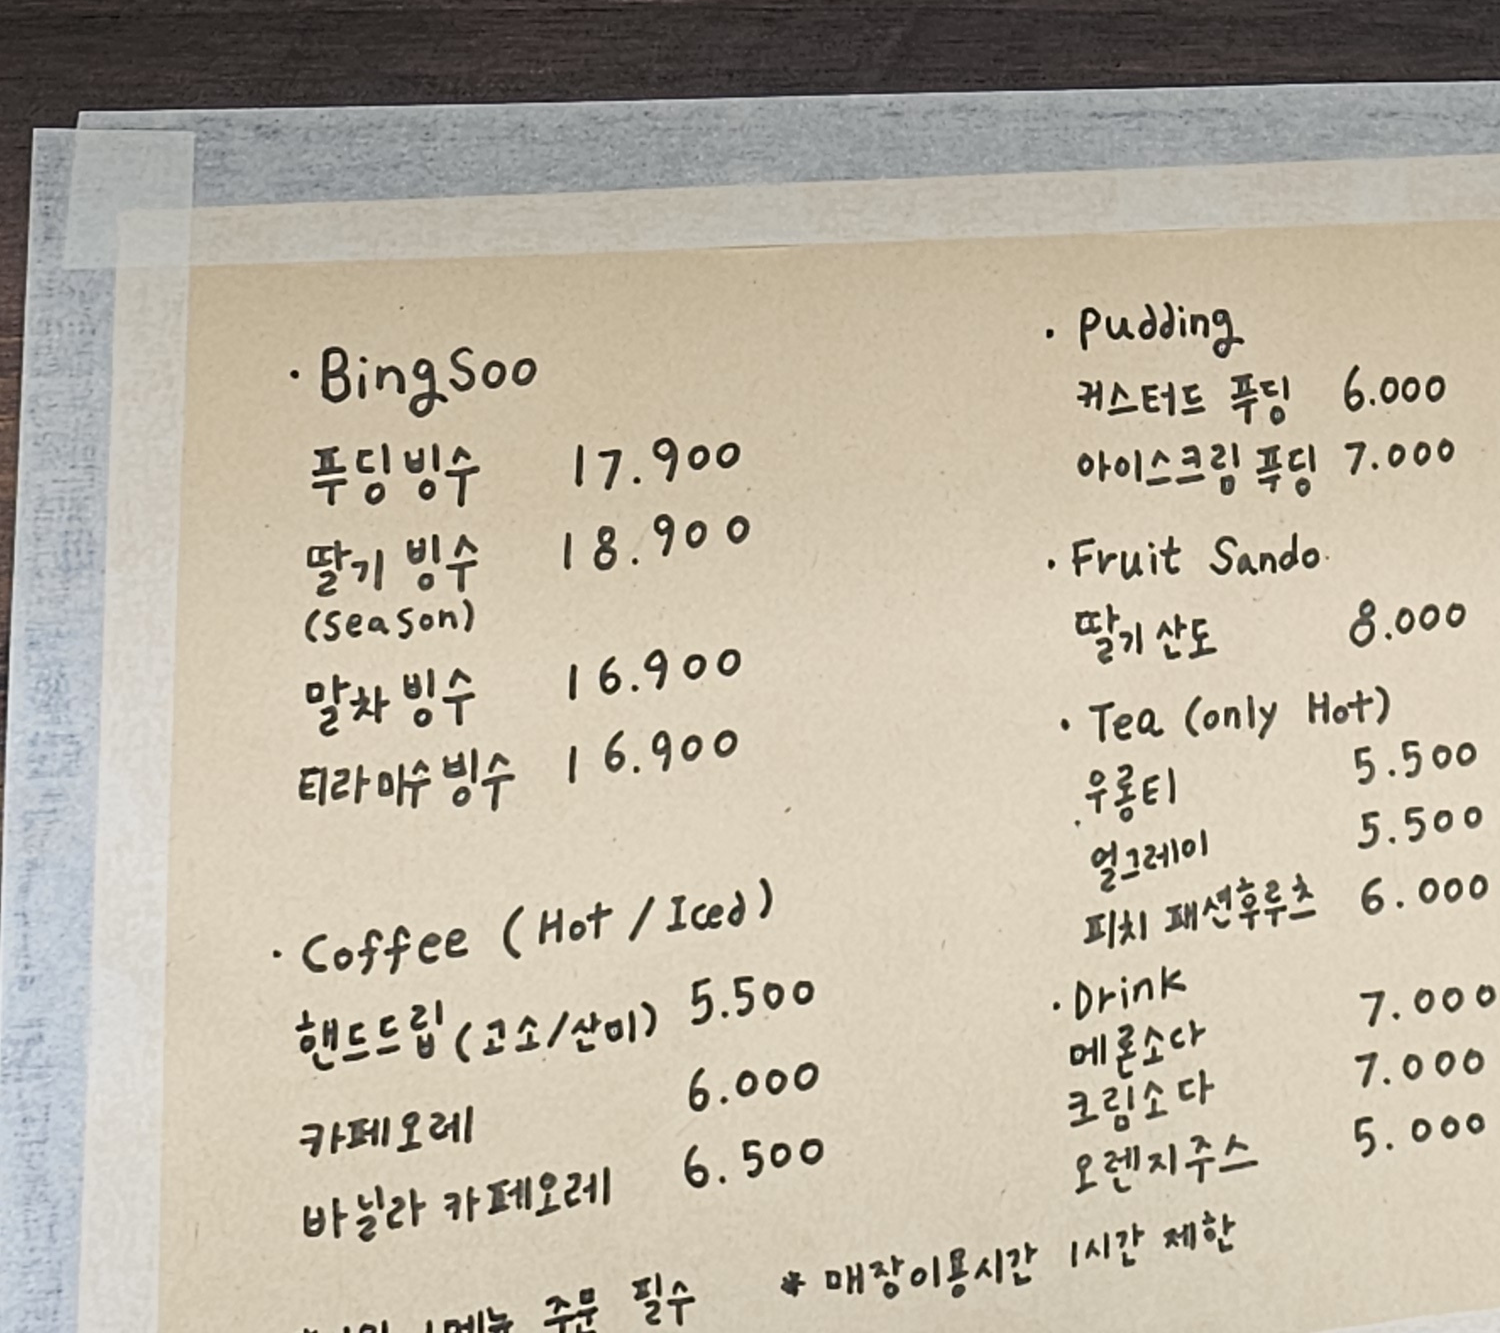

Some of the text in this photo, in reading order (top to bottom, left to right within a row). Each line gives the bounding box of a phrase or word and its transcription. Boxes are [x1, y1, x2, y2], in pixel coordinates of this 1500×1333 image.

[1080, 302, 1244, 358] Pudding
[1077, 365, 1445, 425] 커스터드 푸딩 6.000
[575, 438, 740, 490] 17.900
[1345, 438, 1454, 475] 7.000
[307, 514, 750, 597] 딸기 빙수 18.900
[1072, 533, 1319, 580] Fruit Sando
[1350, 599, 1466, 647] 8.000
[569, 649, 741, 700] 16.900
[1089, 686, 1389, 742] Tea (only Hot)
[569, 730, 737, 783] 16.900
[1085, 741, 1476, 822] 우롱티 5.500
[1091, 807, 1482, 892] 얼그레이 5.500
[1084, 910, 1146, 949] 피치
[1362, 875, 1488, 915] 6.000
[302, 925, 468, 975] Coffee
[691, 976, 814, 1025] 5.500
[1076, 966, 1186, 1020] Drink
[1070, 985, 1496, 1079] 메론소다 7.000
[300, 1062, 818, 1157] 카페오레 6.000
[1068, 1049, 1484, 1132] 크림소다 7.000
[1076, 1113, 1485, 1194] 오렌지주스 5.000
[304, 1139, 823, 1242] 바닐라 카페오레 6.500
[1072, 1223, 1144, 1267] 1시간
[1163, 1211, 1236, 1253] 제한
[632, 1273, 695, 1326] 필수
